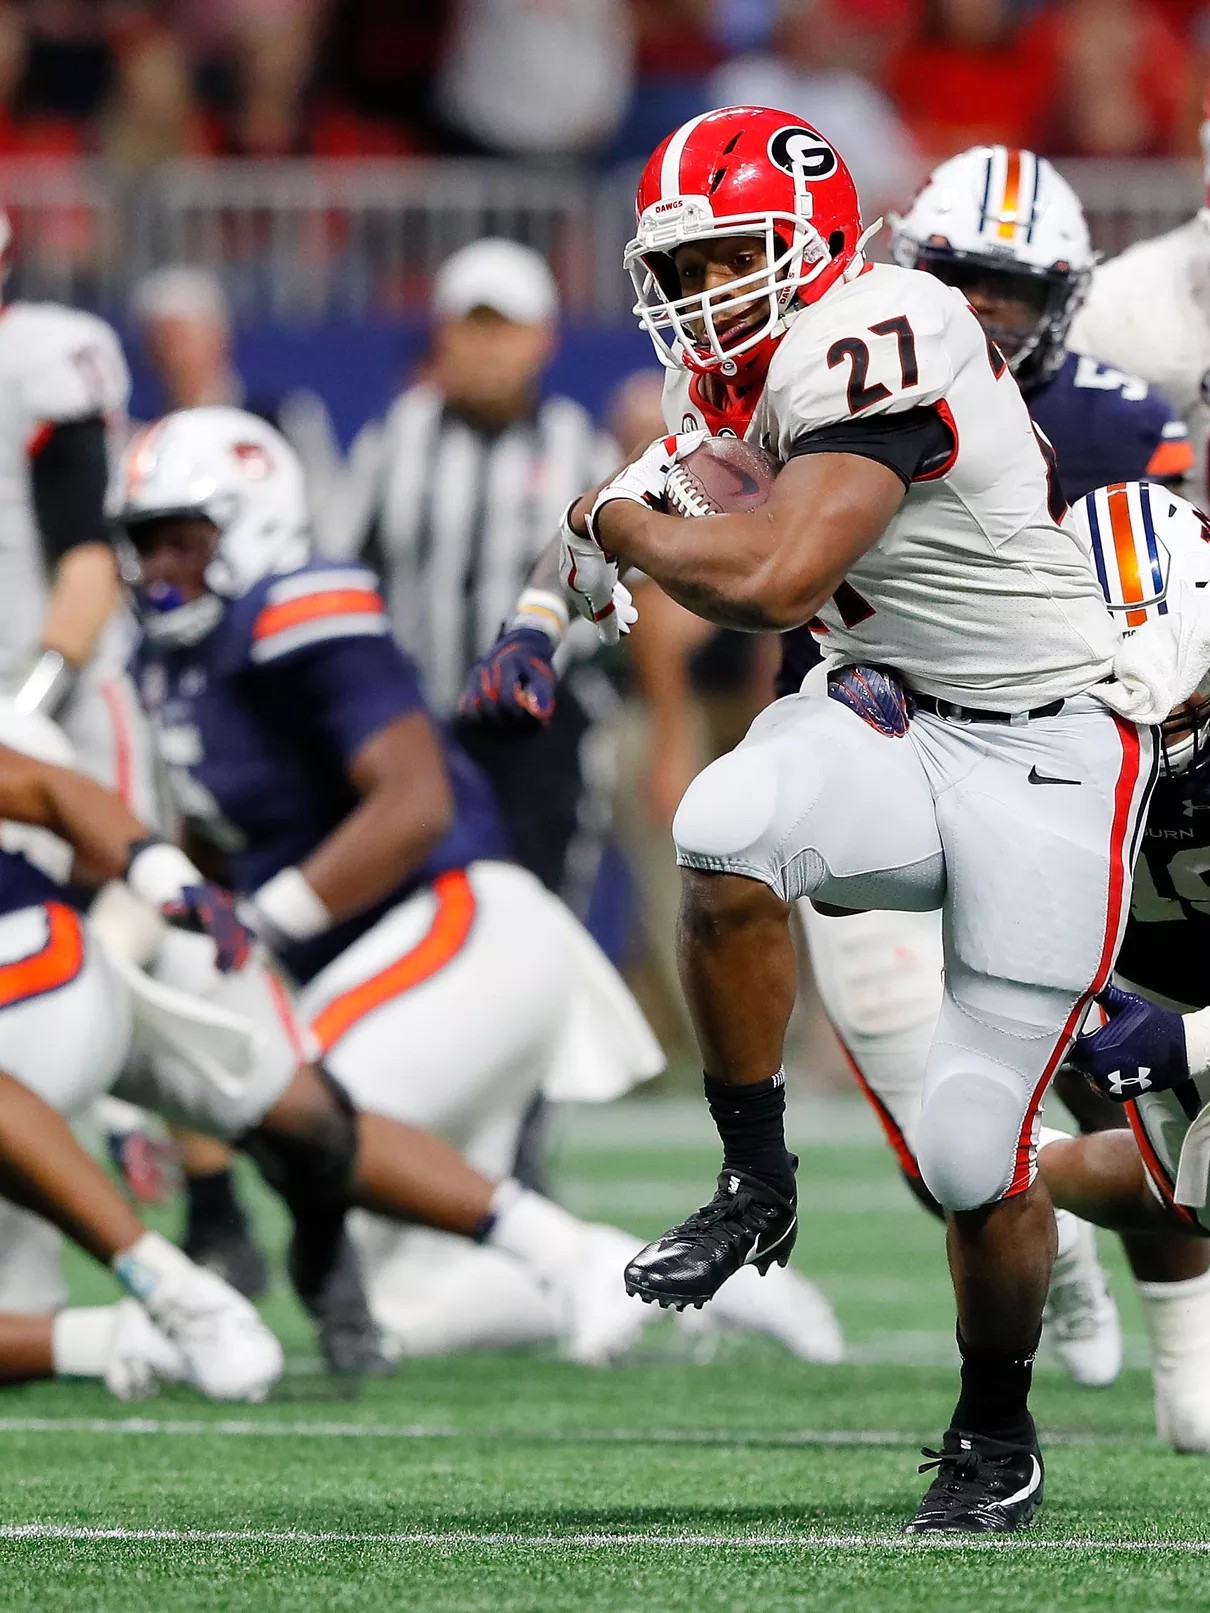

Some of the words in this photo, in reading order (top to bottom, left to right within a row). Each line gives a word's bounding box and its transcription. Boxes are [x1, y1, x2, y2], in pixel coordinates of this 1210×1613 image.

[767, 126, 838, 181] G
[655, 200, 683, 214] DAWGS
[826, 314, 919, 415] 27
